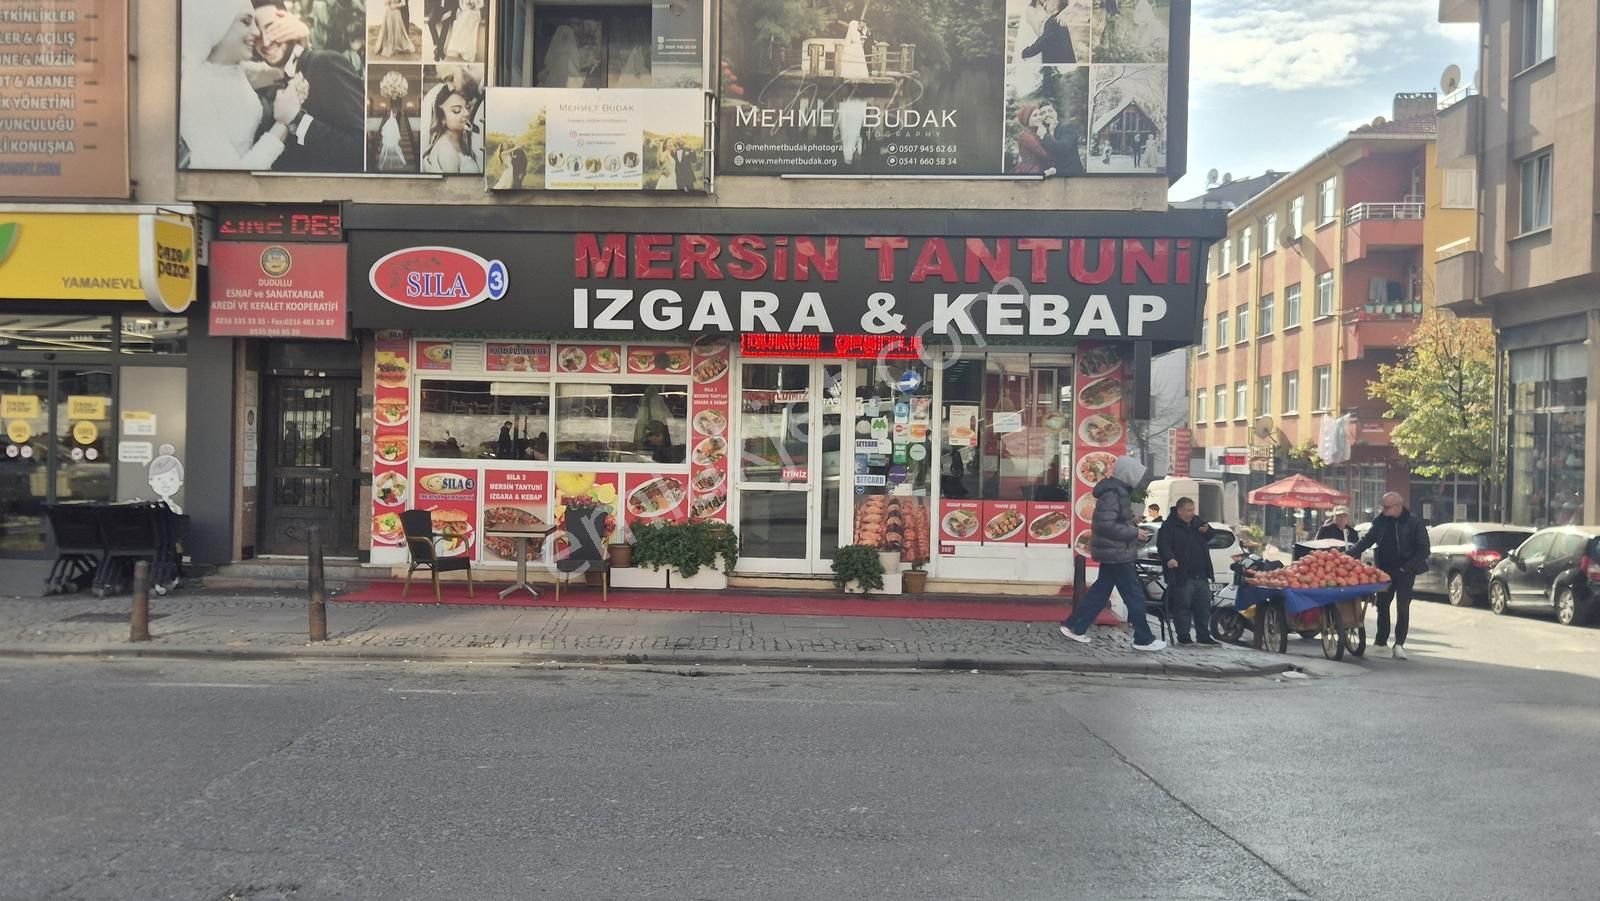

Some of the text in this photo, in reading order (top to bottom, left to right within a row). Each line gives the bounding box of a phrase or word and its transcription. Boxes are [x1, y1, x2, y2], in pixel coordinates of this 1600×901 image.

[23, 32, 33, 44] &
[35, 32, 76, 47] AÇILIŞ
[22, 54, 31, 65] &
[35, 50, 76, 65] MÜZİK
[26, 76, 76, 88] ARANJE
[13, 94, 75, 109] YÖNETİMİ
[863, 106, 957, 127] BUDAK
[10, 141, 75, 156] KONUŞMA
[899, 144, 957, 153] 0507 945 62 63
[745, 157, 838, 166] www.mehmetbudak.org
[899, 157, 957, 166] 0541 660 58 34
[258, 279, 293, 287] DUDULLU
[407, 271, 504, 298] SILA 3
[226, 290, 252, 298] ESNAF
[265, 290, 324, 299] SANATKARLAR
[211, 301, 338, 312] KREDİ VE KEFALET KOOPERATİFİ
[573, 289, 1168, 337] IZGARA & KEBAP
[442, 478, 463, 489] SILA
